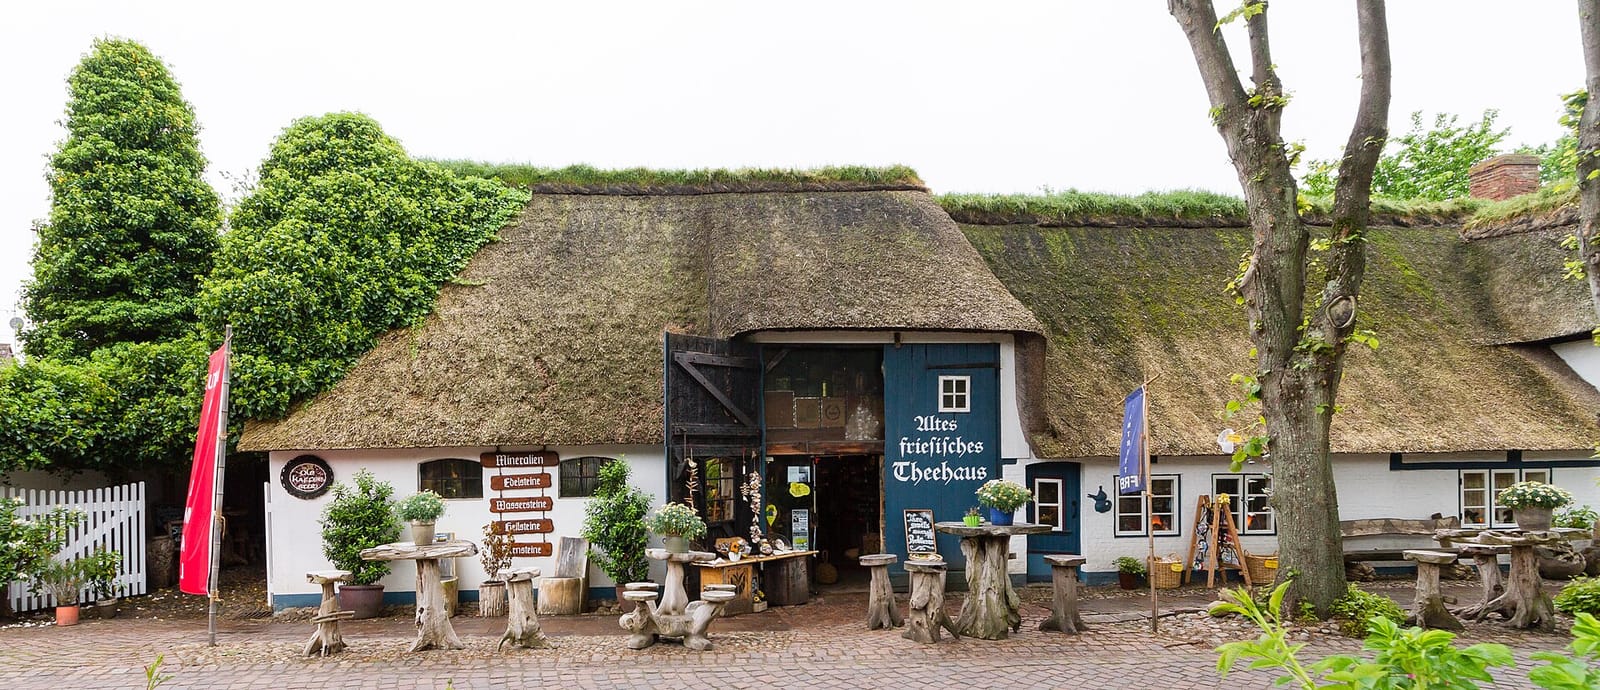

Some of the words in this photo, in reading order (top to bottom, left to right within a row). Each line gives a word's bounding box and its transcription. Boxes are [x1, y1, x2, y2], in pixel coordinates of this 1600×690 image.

[913, 415, 958, 431] Altes
[496, 454, 544, 466] Mineralien
[892, 461, 988, 486] Theehaus
[503, 477, 541, 488] Edelsteine
[496, 500, 547, 511] Wassersteine
